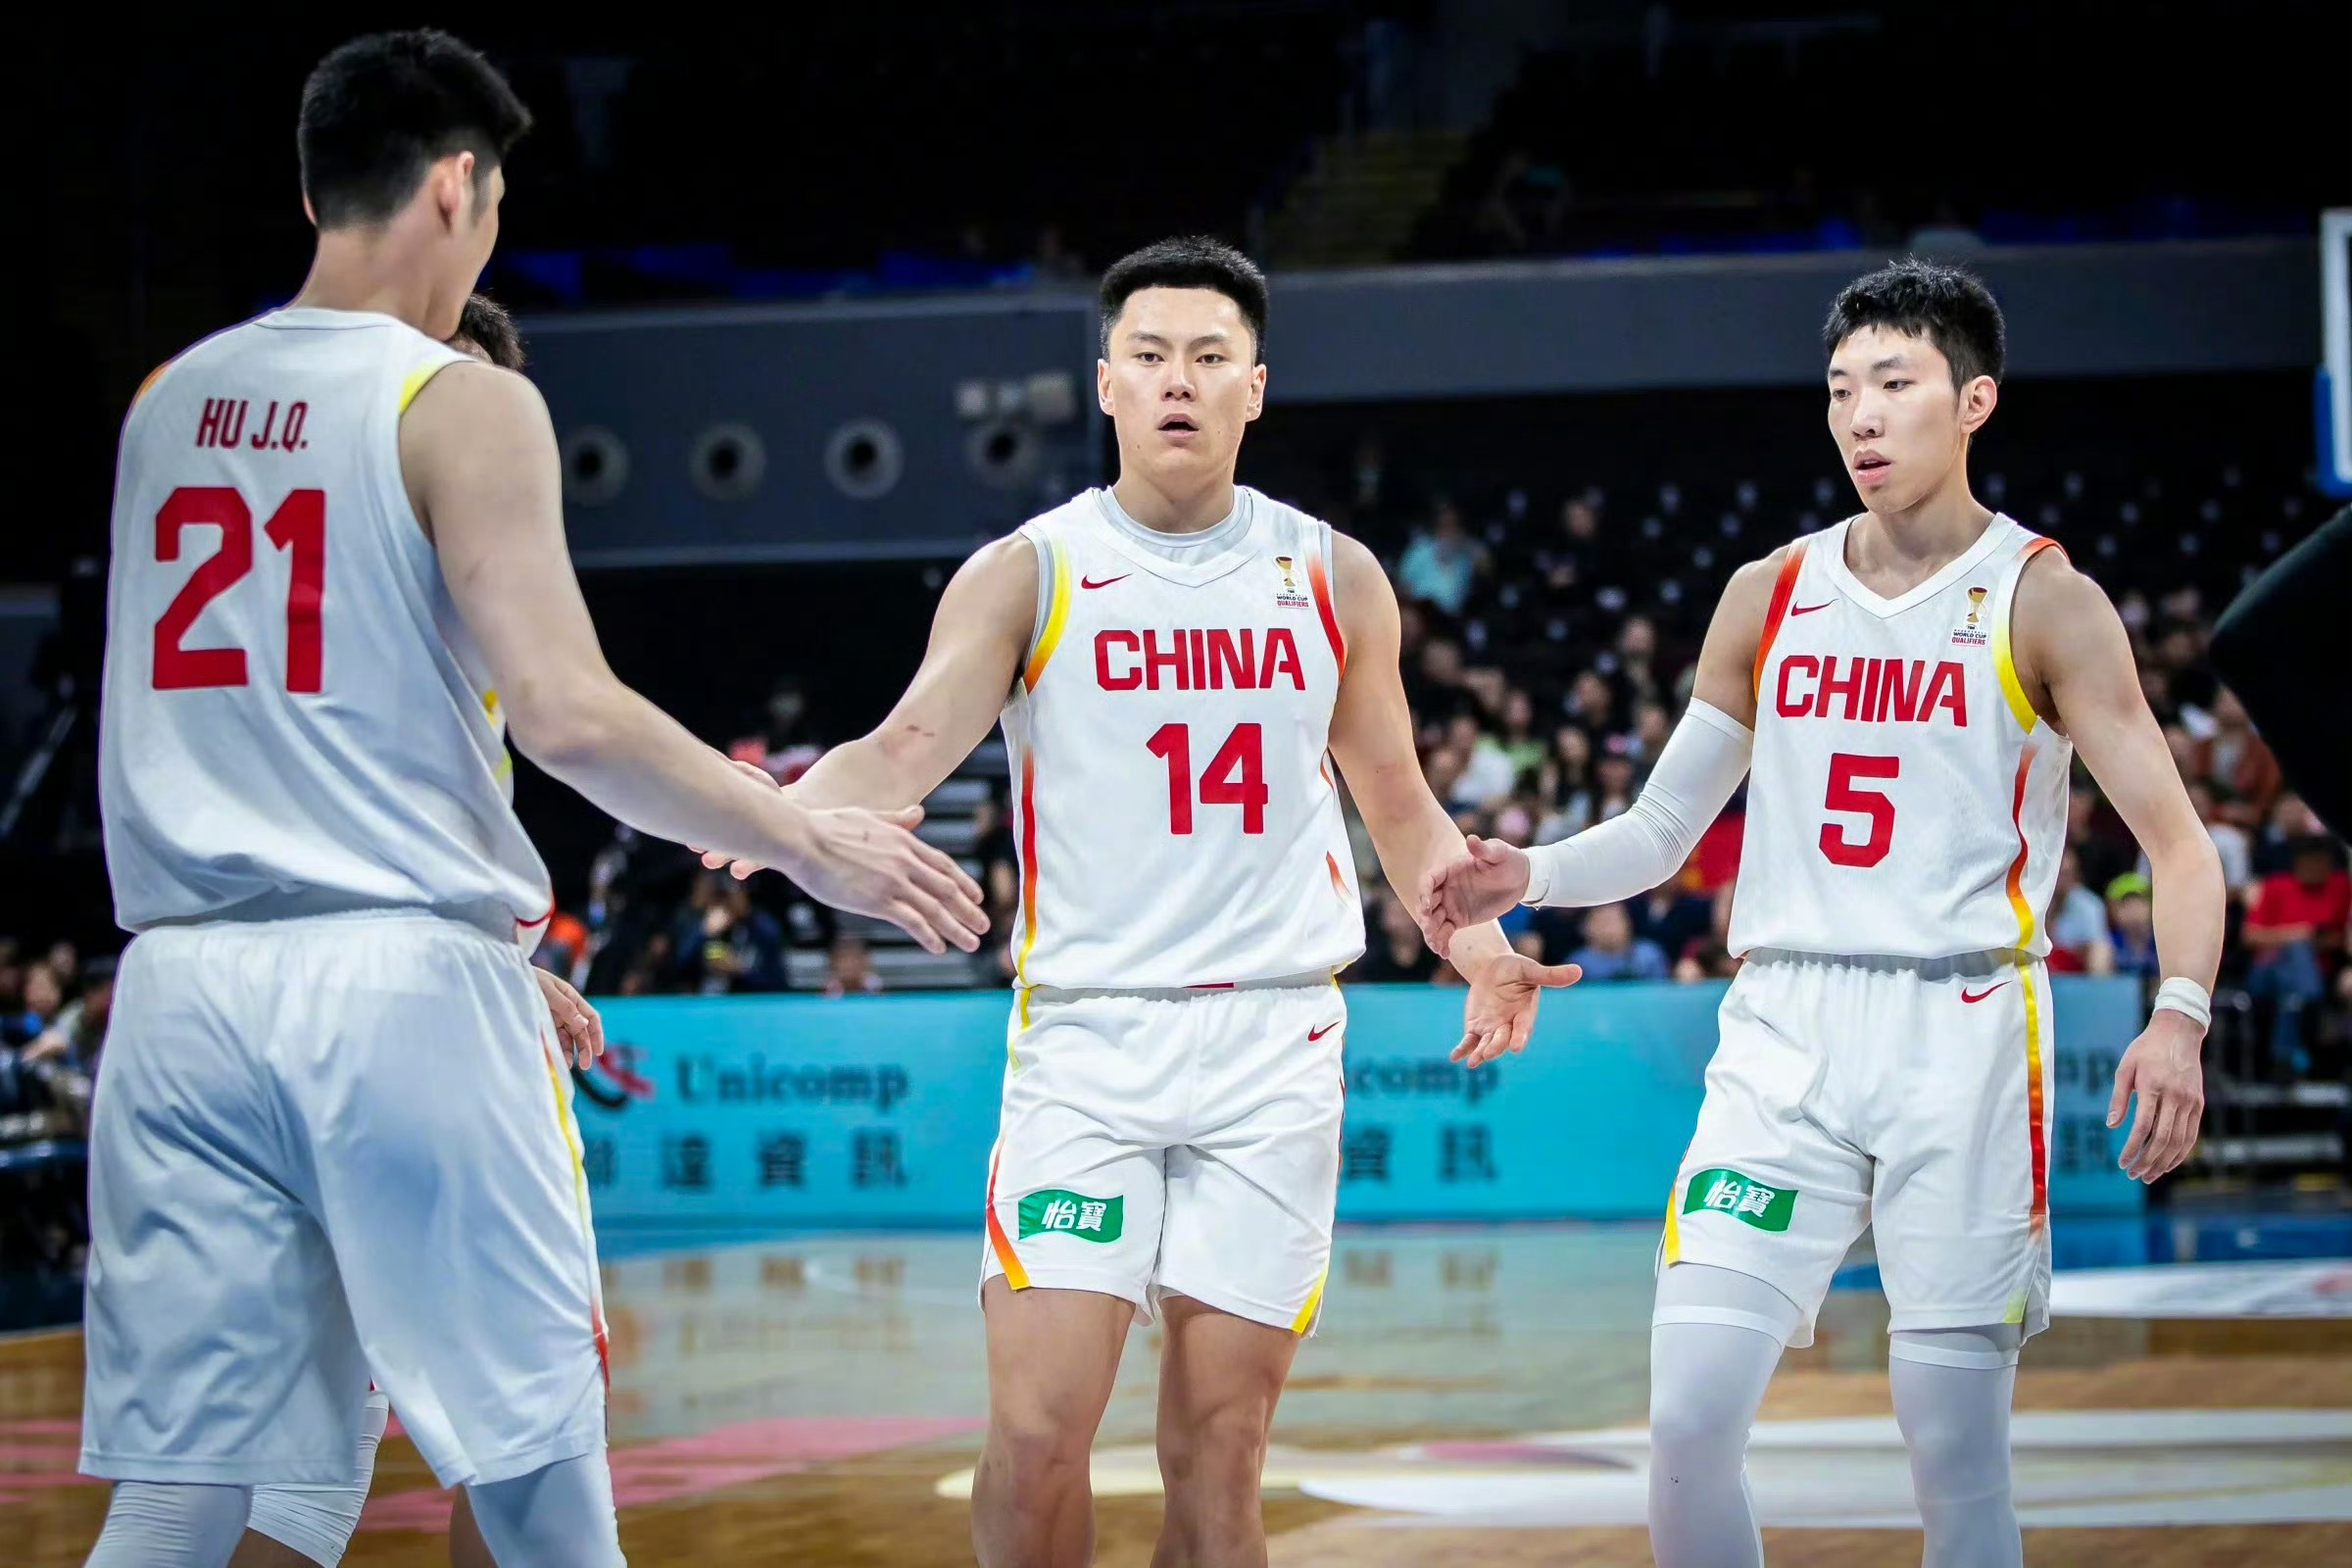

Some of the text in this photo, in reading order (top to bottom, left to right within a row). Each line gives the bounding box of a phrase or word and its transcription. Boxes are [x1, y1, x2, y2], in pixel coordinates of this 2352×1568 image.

[195, 397, 309, 453] HU J.Q.
[152, 486, 326, 694] 21
[1094, 628, 1306, 691] CHINA
[1776, 655, 1968, 727] CHINA
[1146, 722, 1268, 834] 14
[1819, 752, 1899, 868] 5
[675, 1051, 910, 1111] Unicomp
[1041, 1200, 1107, 1232] 怡寶
[1703, 1179, 1776, 1217] 怡寶
